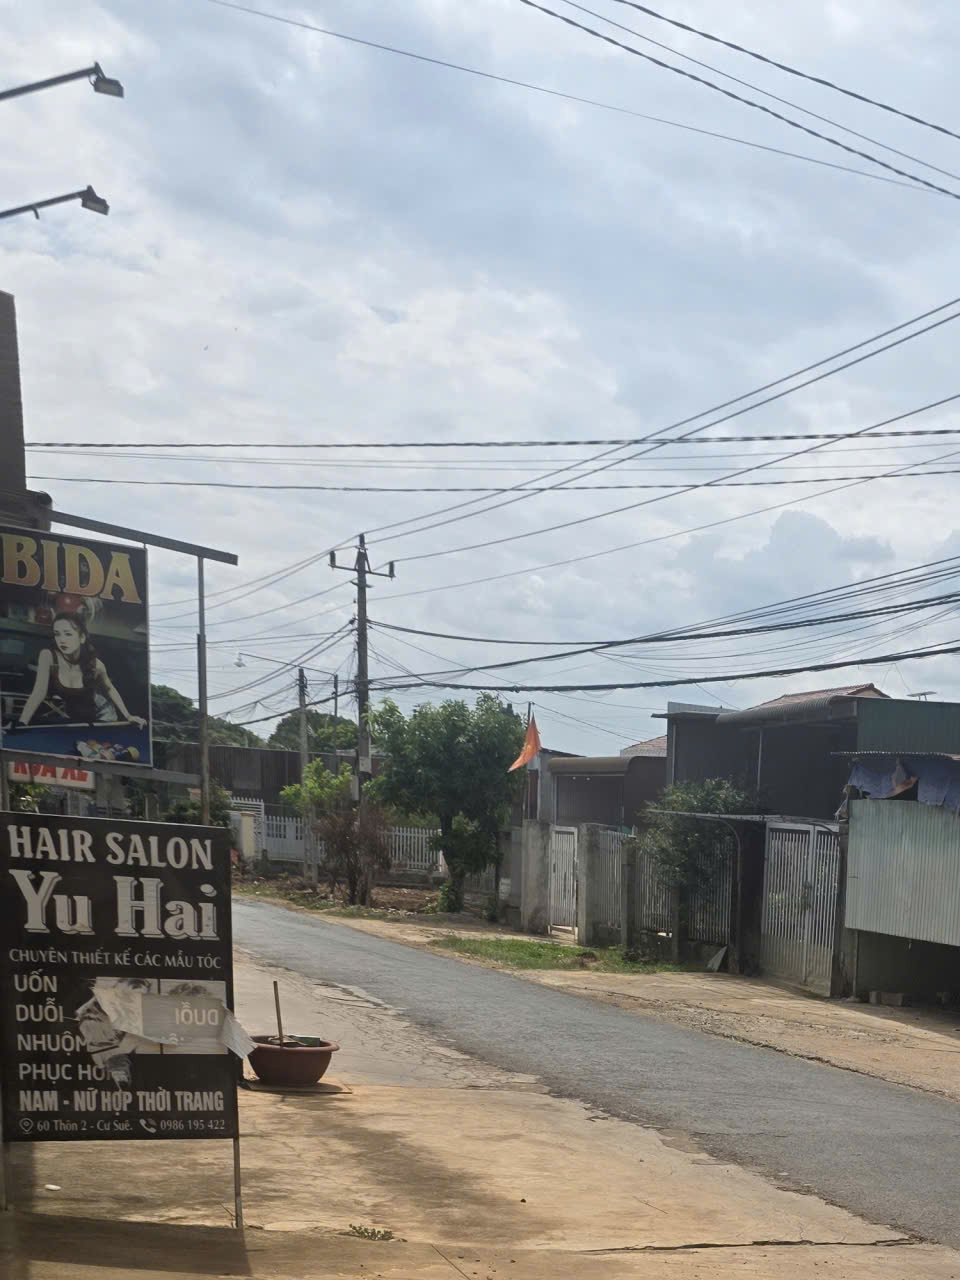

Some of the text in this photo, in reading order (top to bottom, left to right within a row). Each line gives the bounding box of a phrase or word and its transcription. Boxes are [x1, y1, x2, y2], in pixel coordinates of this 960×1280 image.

[0, 533, 142, 604] BIDA
[7, 824, 214, 870] HAIR SALON
[8, 868, 220, 941] Yu Hai
[9, 946, 68, 964] CHUYÊN
[71, 946, 110, 965] THIẾT
[114, 947, 131, 966] KẾ
[134, 950, 161, 967] CÁC
[196, 953, 221, 969] TÓC
[14, 968, 57, 992] UỐN
[16, 997, 63, 1023] DUỖI
[19, 1063, 73, 1084] PHỤC
[20, 1090, 58, 1112] NAM
[73, 1087, 98, 1112] NỮ
[101, 1088, 132, 1116] HỢP
[136, 1086, 171, 1112] THỜI
[174, 1090, 225, 1112] TRANG
[36, 1120, 50, 1132] 60
[53, 1119, 78, 1132] Thôn
[81, 1120, 88, 1131] 2
[160, 1119, 225, 1131] 0986 195 422
